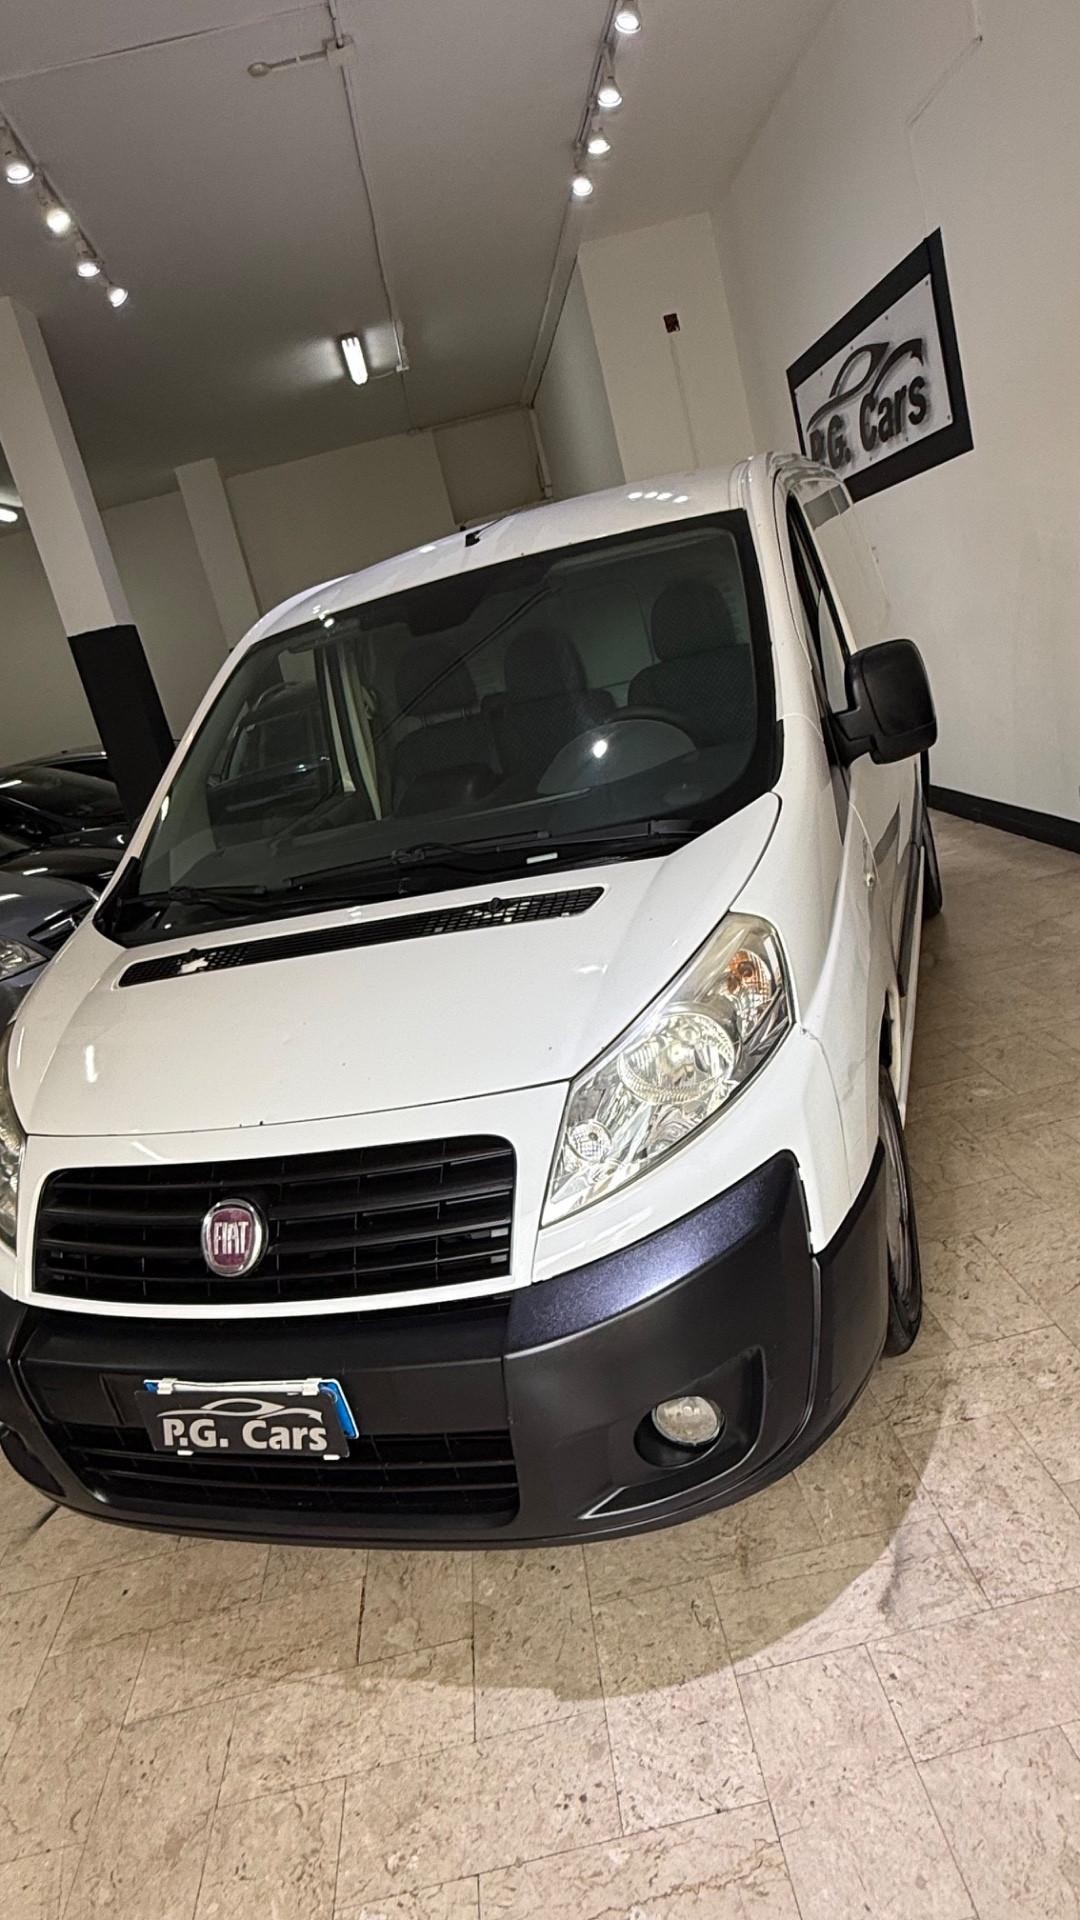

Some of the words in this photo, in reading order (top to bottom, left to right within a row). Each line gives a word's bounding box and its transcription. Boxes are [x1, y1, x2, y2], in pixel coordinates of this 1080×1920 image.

[810, 415, 851, 469] PG.
[859, 376, 927, 451] Cars
[213, 1221, 249, 1255] FIAT
[162, 1418, 229, 1448] P.G.
[242, 1419, 328, 1451] Cars
